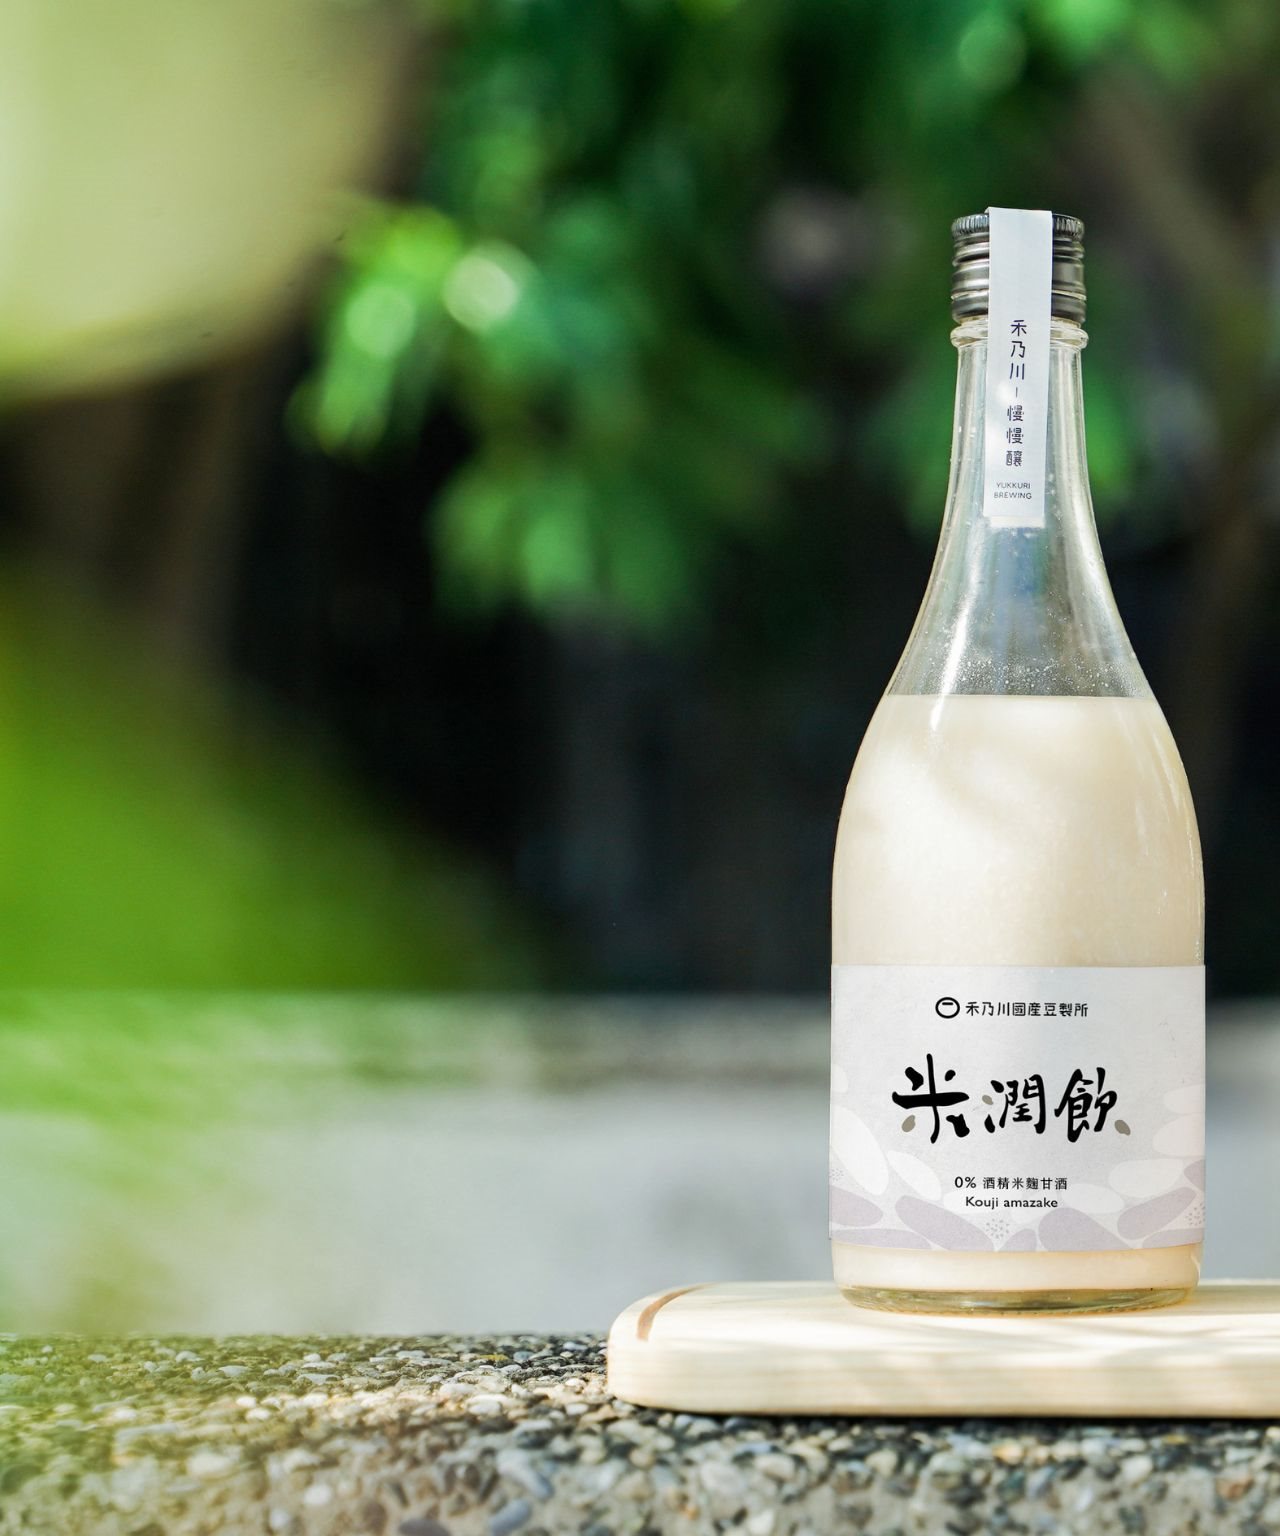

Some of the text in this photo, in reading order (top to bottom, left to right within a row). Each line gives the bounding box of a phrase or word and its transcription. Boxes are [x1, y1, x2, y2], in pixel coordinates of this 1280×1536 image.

[993, 491, 1032, 499] BREWING
[891, 1053, 1128, 1143] 米潤飲
[954, 1176, 977, 1189] 0%
[965, 1196, 1058, 1210] Kouji amazake
